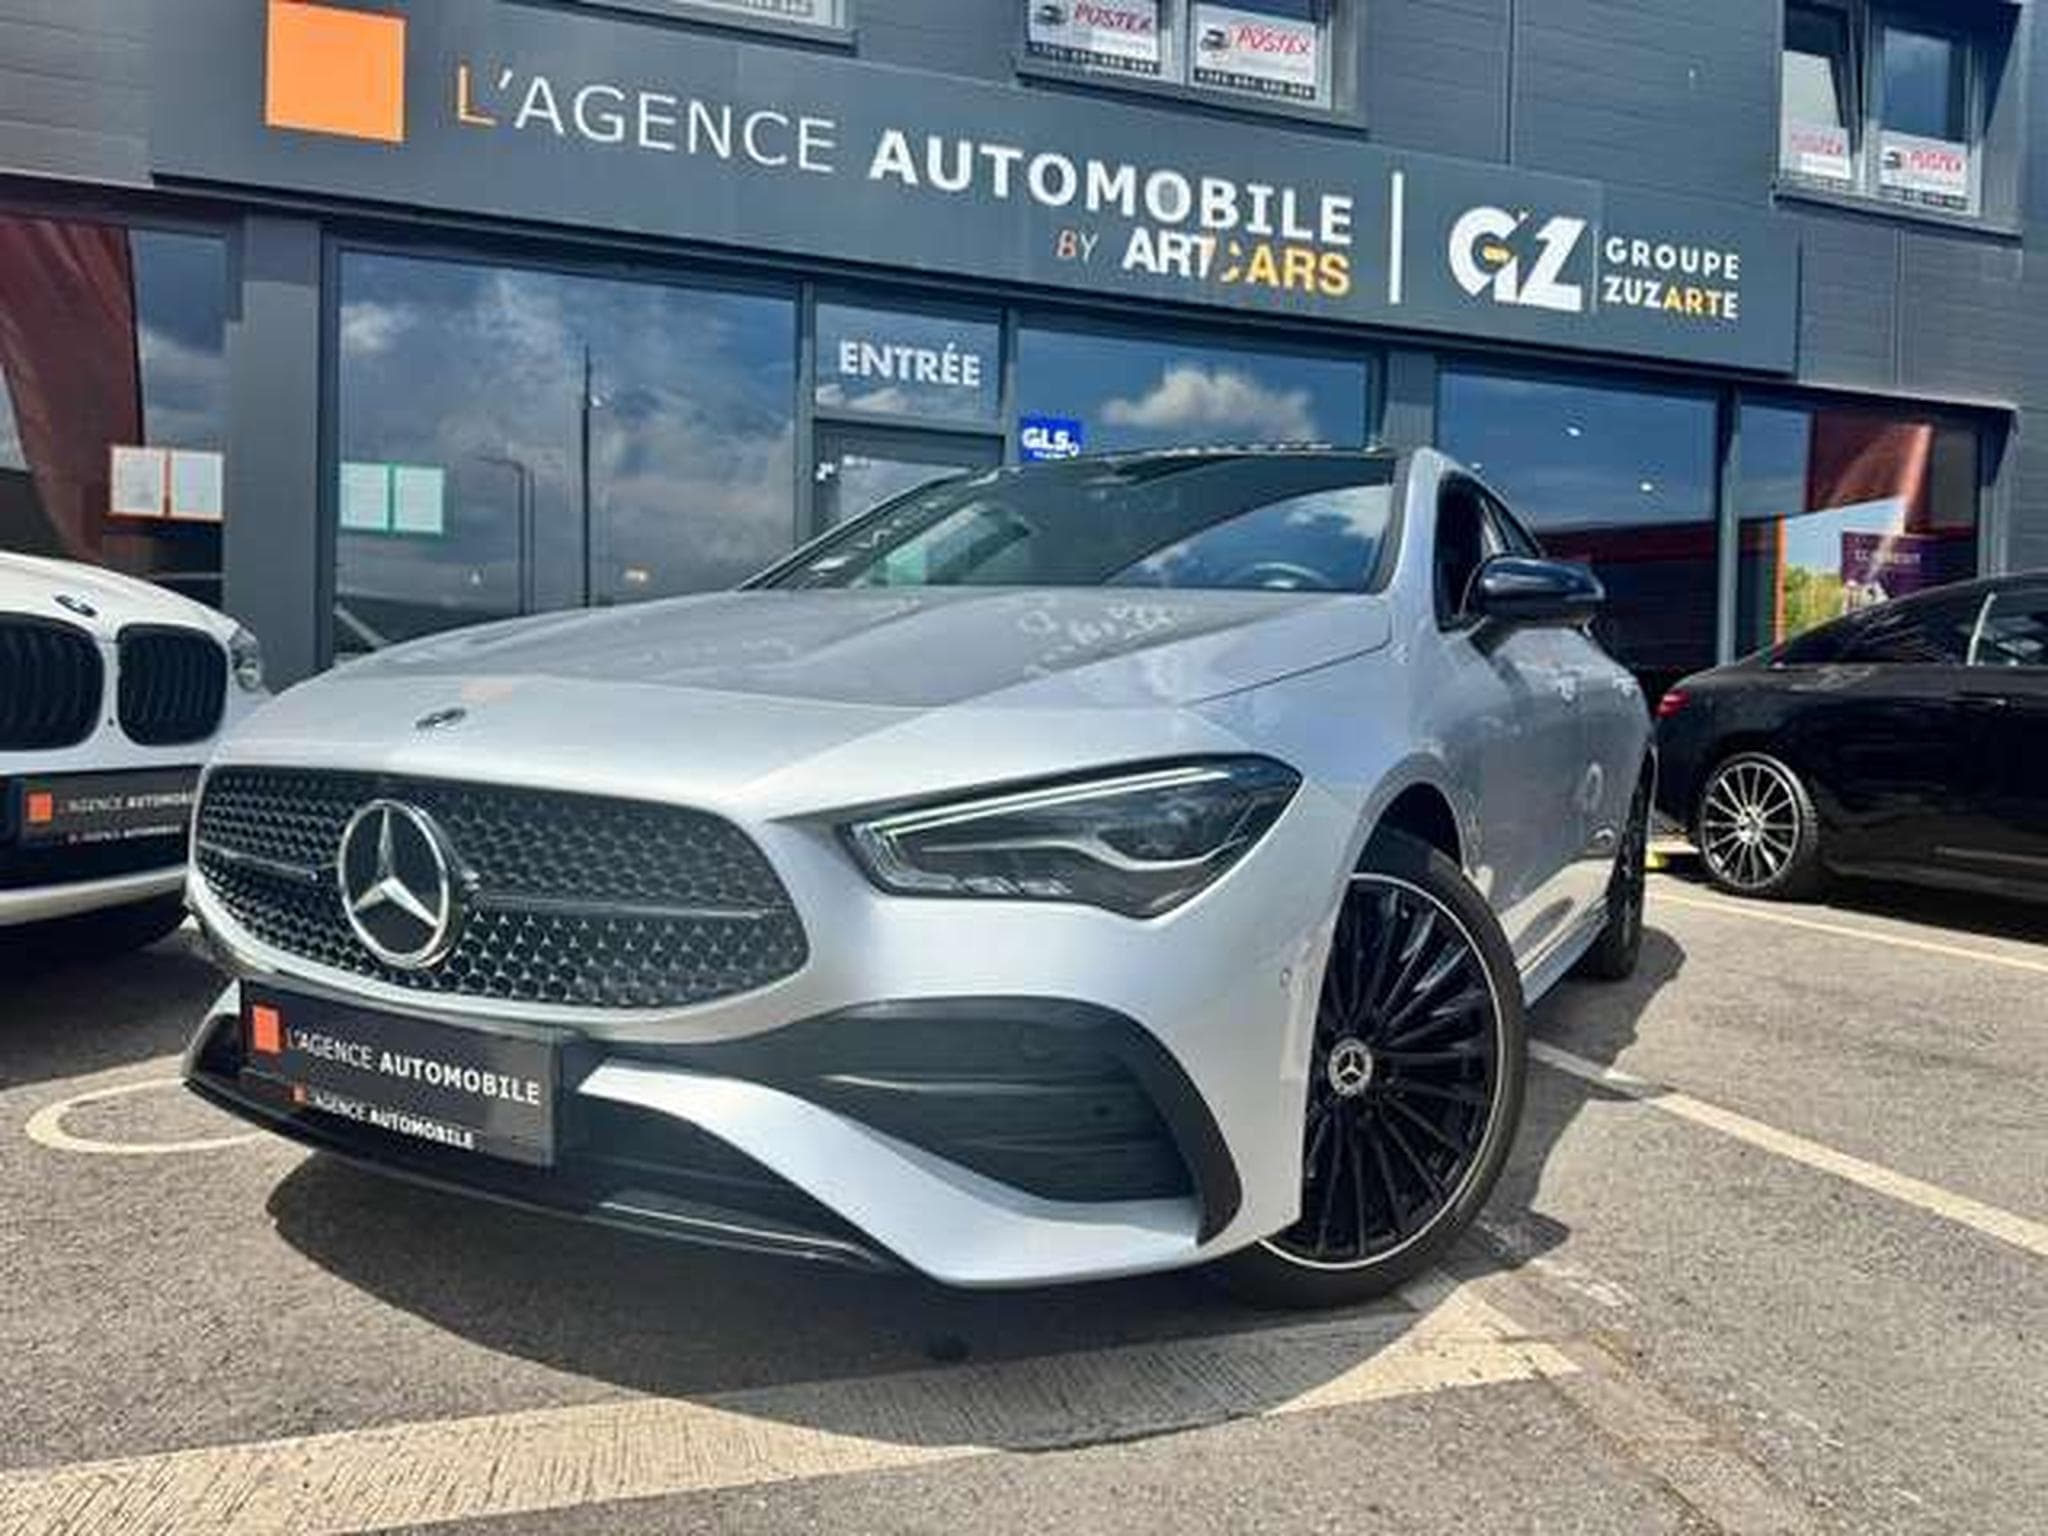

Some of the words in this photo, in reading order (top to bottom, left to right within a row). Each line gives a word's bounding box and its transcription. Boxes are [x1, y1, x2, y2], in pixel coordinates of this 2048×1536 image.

[457, 65, 837, 173] L'AGENCE
[868, 129, 1354, 246] AUTOMOBILE
[1056, 229, 1099, 262] BY
[1606, 236, 1740, 281] GROUPE
[1603, 276, 1740, 320] ZUZARTE
[839, 341, 981, 387] ENTRÉE
[1022, 427, 1070, 452] GLS
[380, 1051, 541, 1105] AUTOMOBILE
[369, 1109, 475, 1150] AUTOMOBILE
